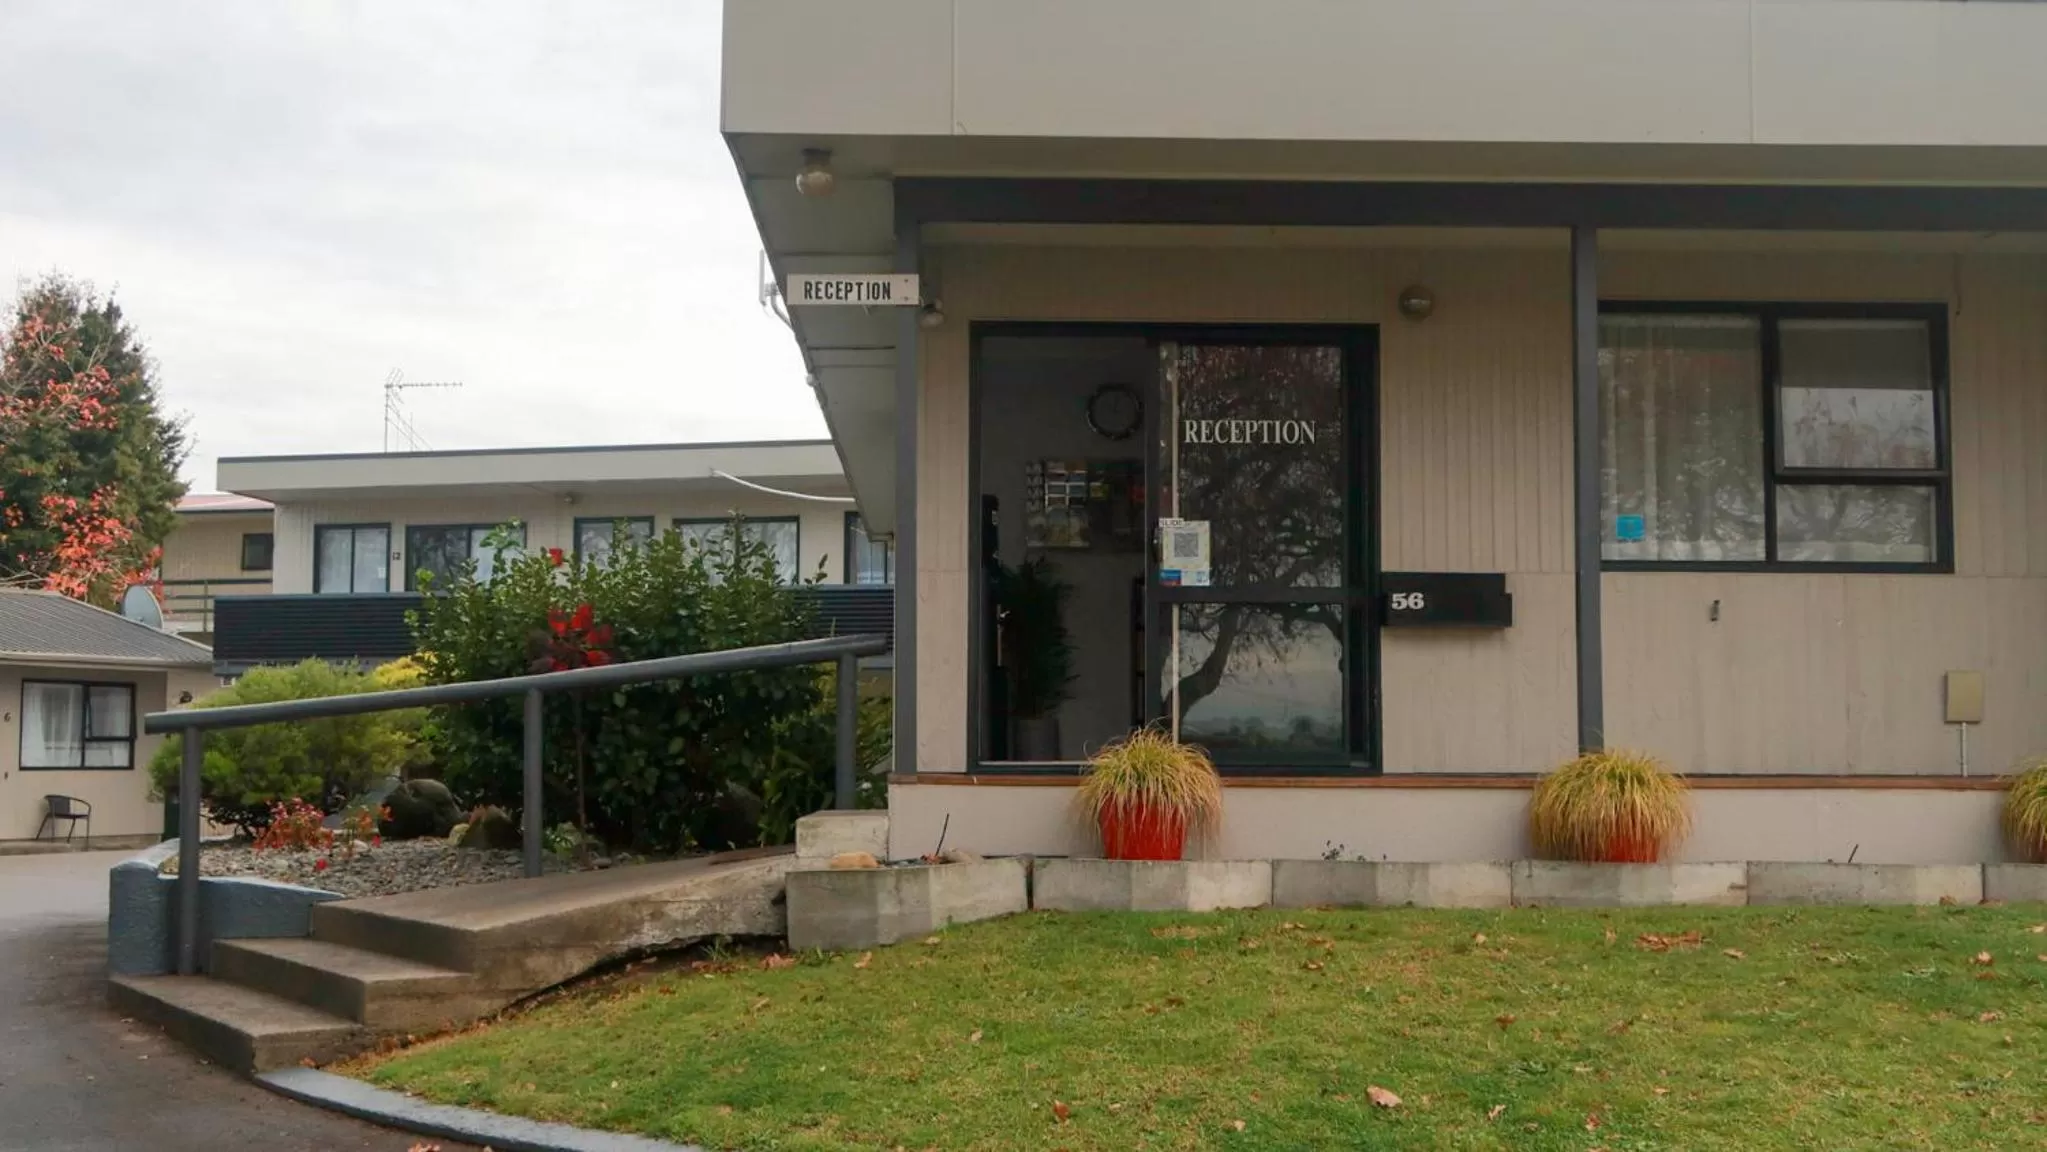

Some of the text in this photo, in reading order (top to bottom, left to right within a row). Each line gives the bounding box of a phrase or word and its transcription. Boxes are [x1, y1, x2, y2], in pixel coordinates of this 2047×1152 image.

[804, 281, 891, 301] RECEPTION
[1184, 419, 1315, 444] RECEPTION
[1391, 592, 1425, 610] 56
